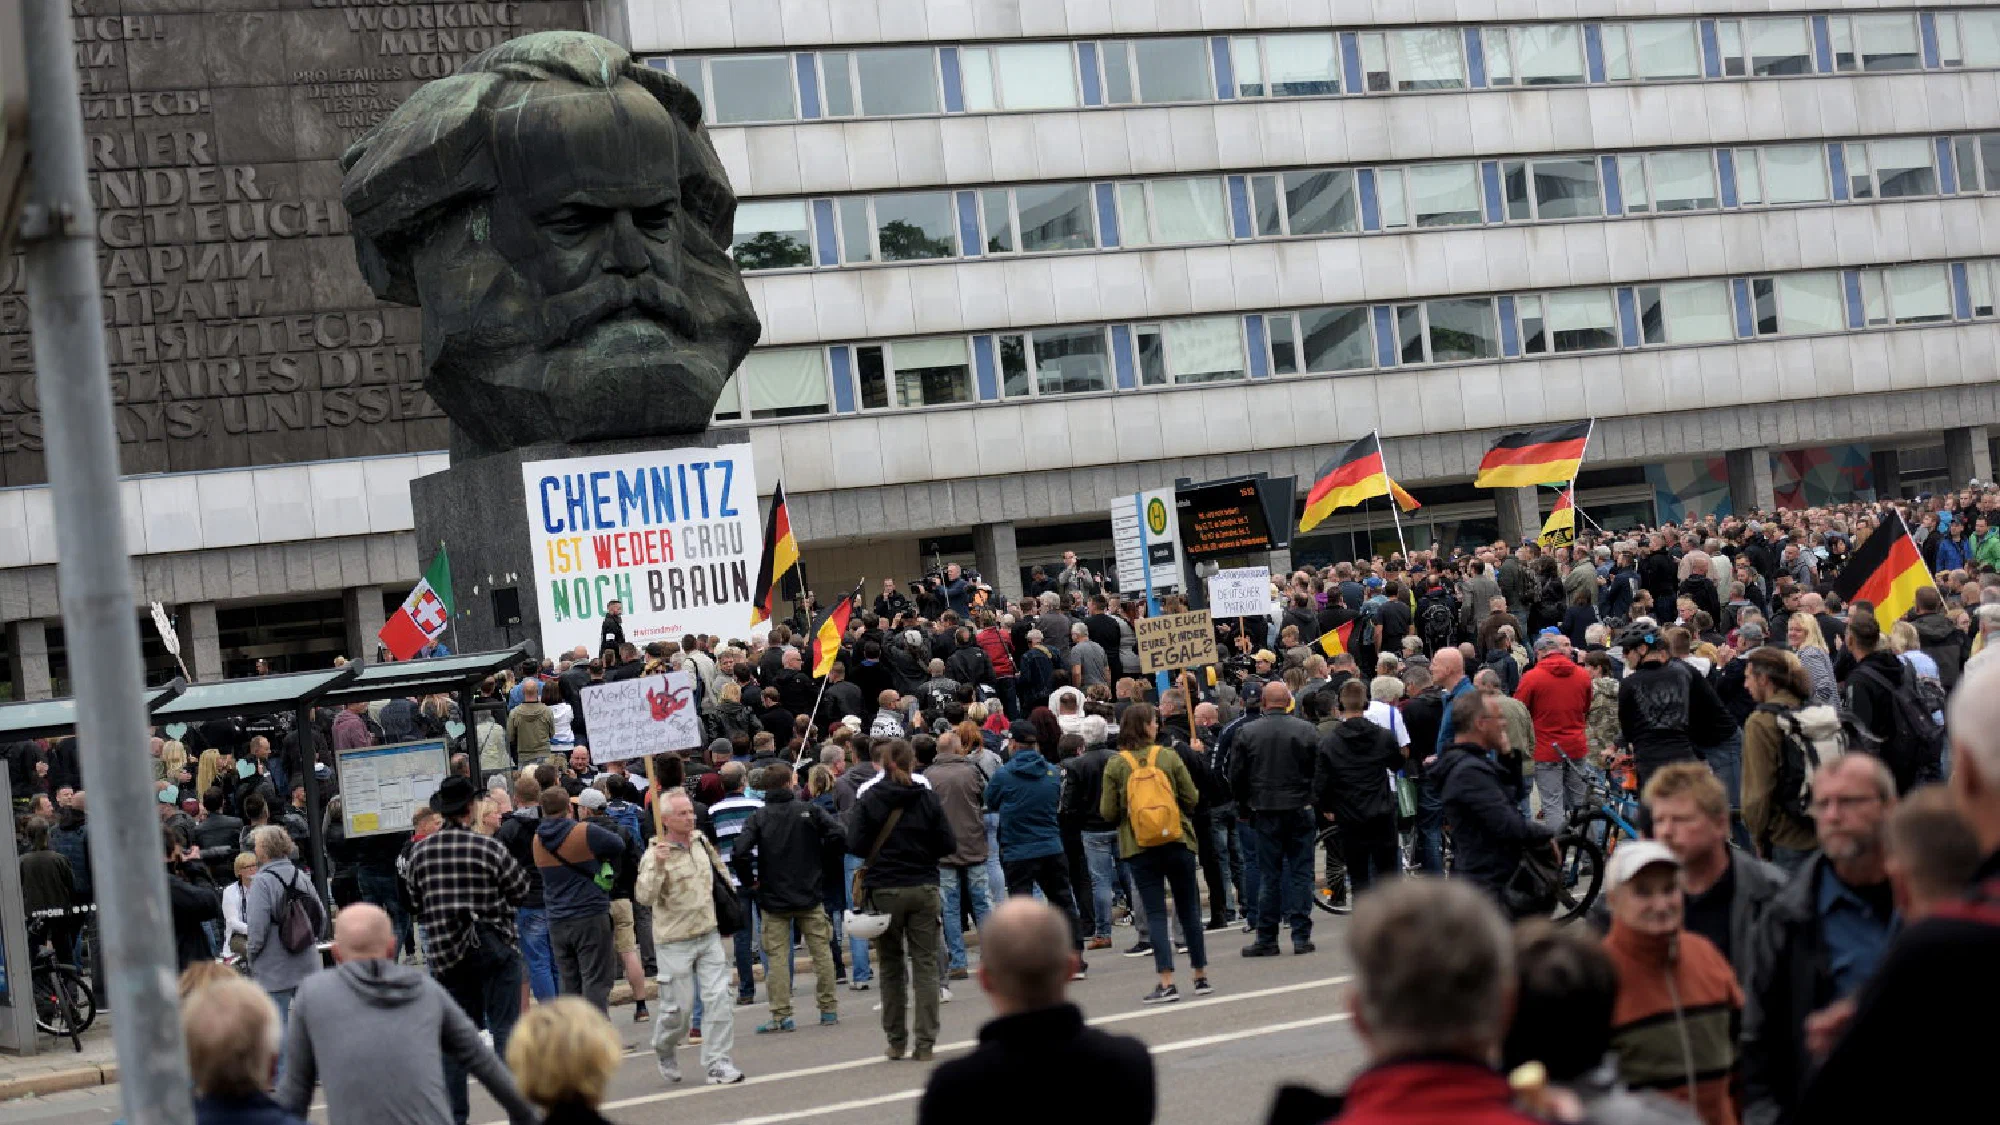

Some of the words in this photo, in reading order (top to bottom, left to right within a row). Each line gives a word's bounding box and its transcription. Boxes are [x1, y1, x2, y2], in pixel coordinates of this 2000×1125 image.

[345, 3, 522, 31] WORKING
[380, 28, 459, 55] MEN
[539, 459, 739, 534] CHEMNITZ
[547, 536, 583, 574] IST
[592, 529, 674, 569] WEDER
[681, 521, 744, 560] GRAU
[552, 572, 634, 622] NOCH
[647, 559, 750, 612] BRAUN
[1139, 619, 1172, 636] SIND
[1174, 612, 1207, 627] EUCH
[1141, 638, 1167, 652] EURE
[1168, 628, 1208, 645] KINDER
[1150, 638, 1213, 668] EGAL?
